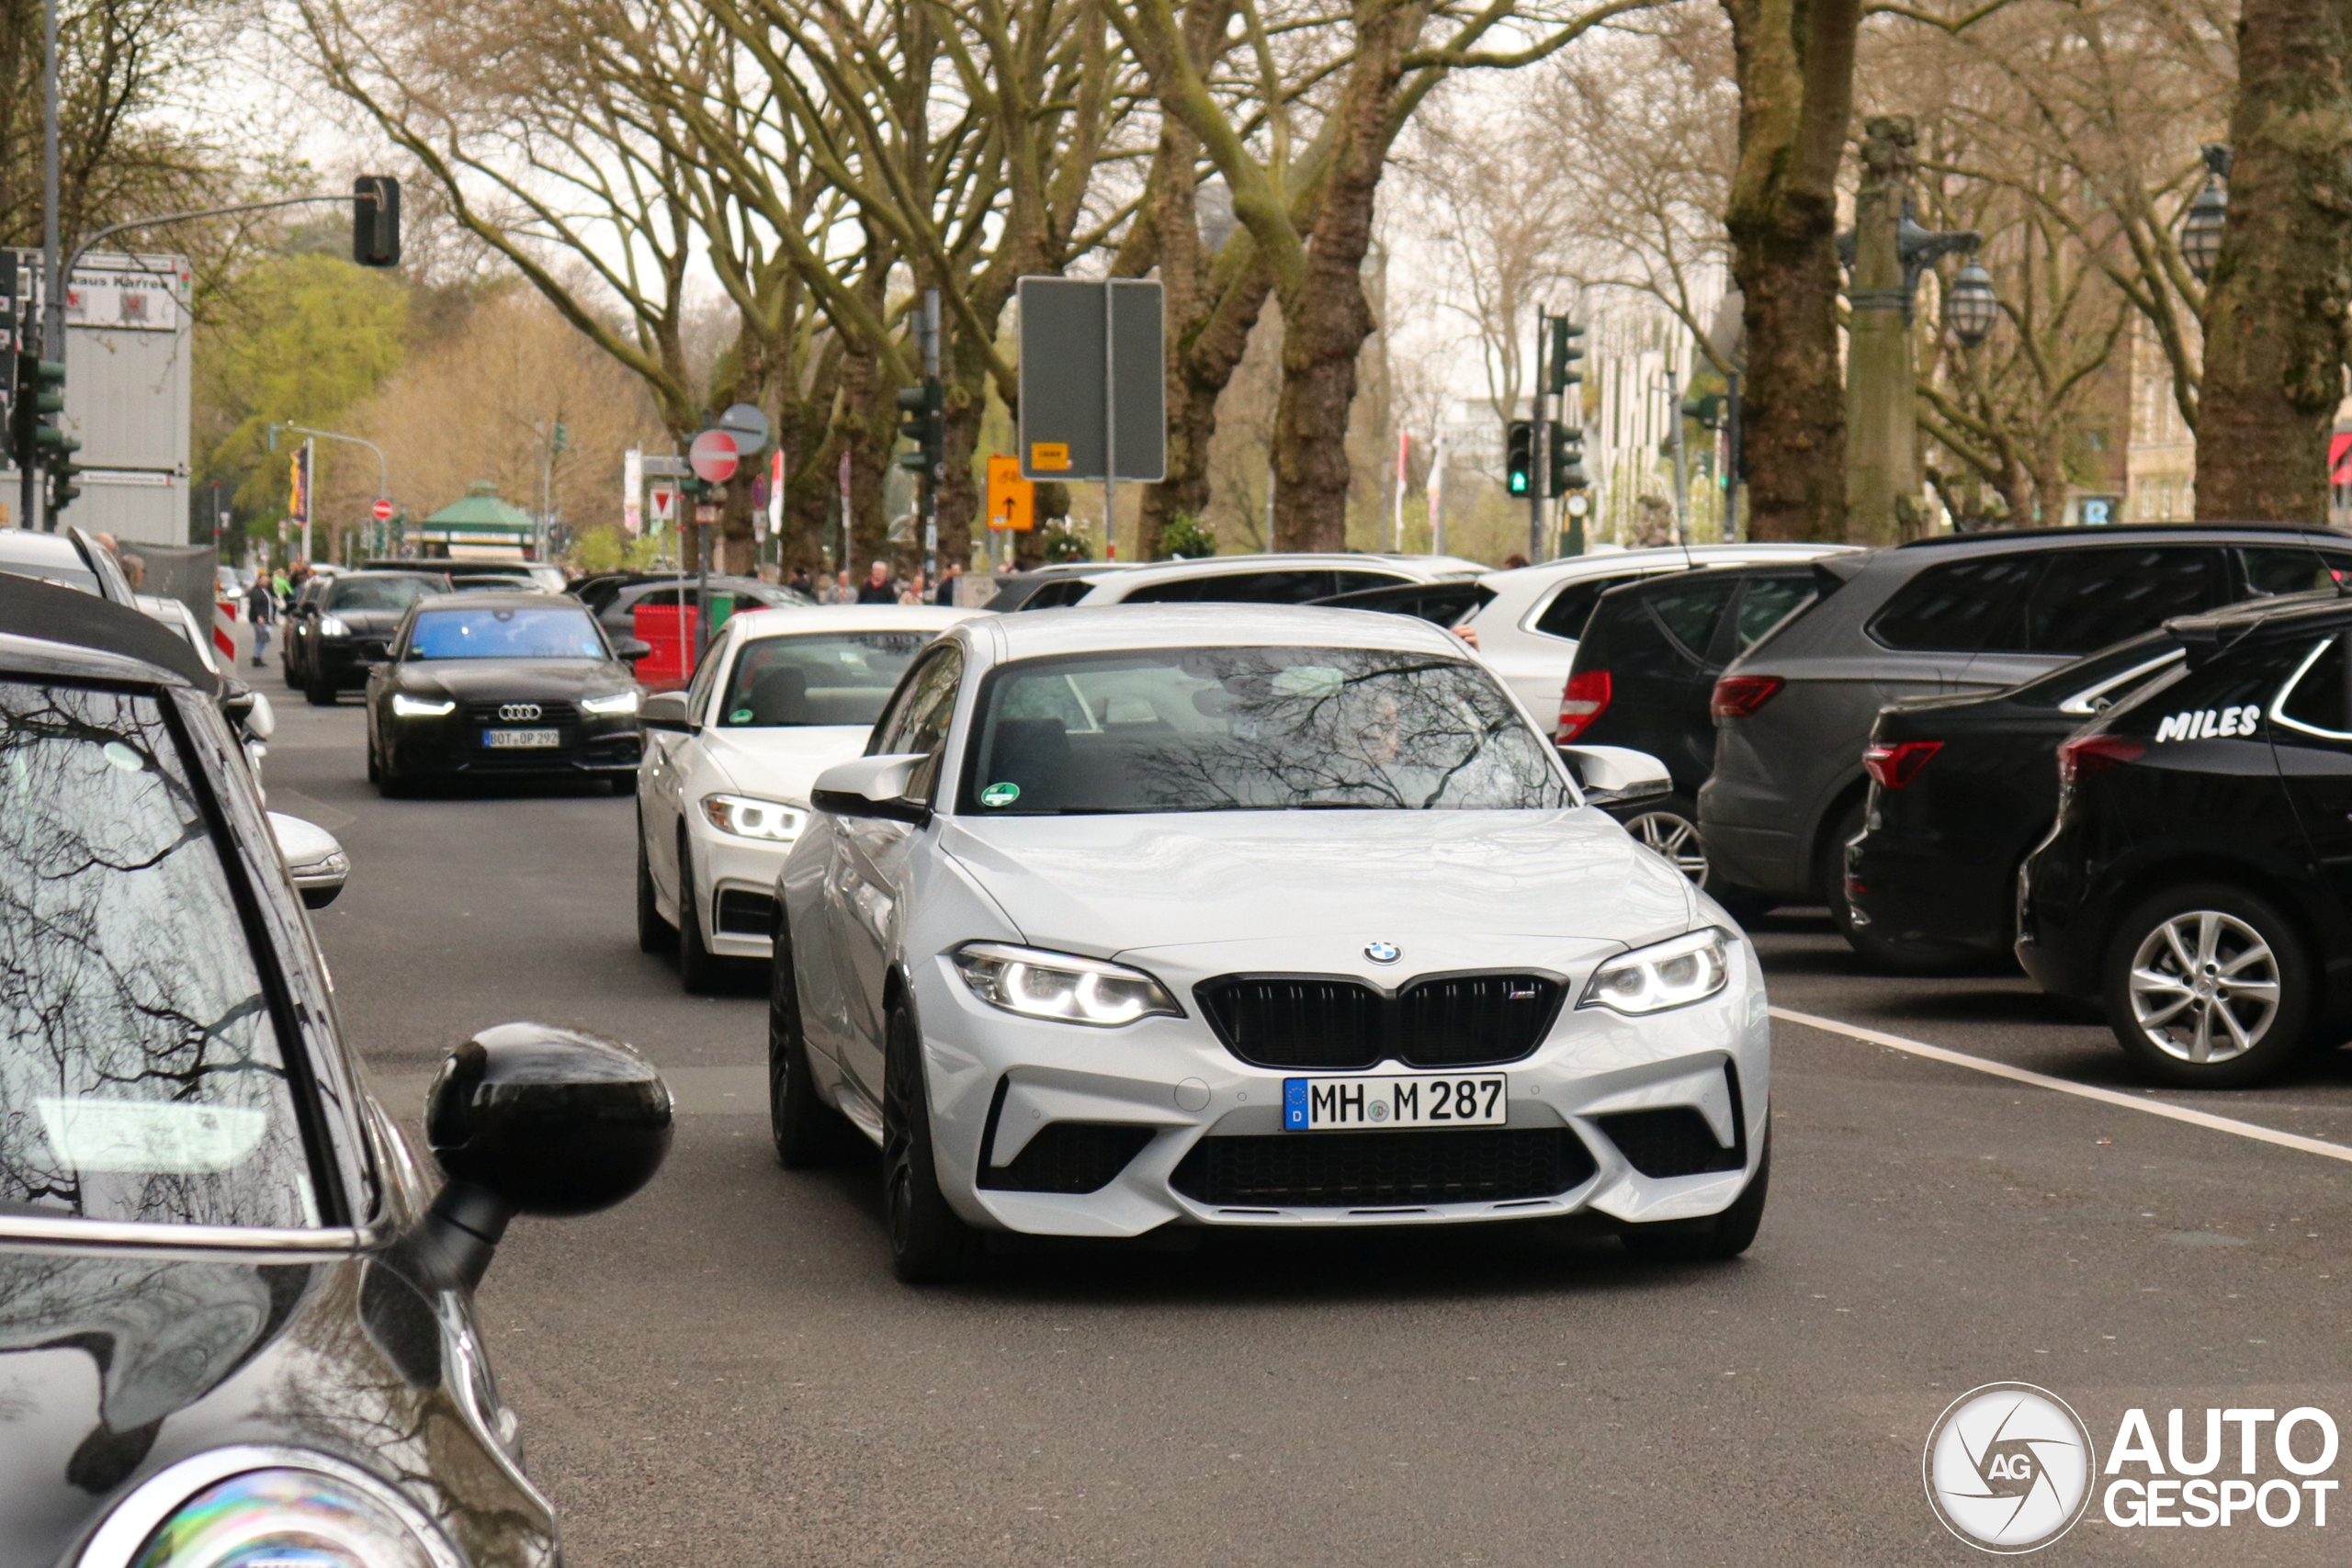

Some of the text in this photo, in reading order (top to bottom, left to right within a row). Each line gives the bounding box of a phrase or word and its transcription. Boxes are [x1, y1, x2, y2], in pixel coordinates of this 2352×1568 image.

[2155, 705, 2261, 743] MILES
[1293, 1079, 1502, 1122] D MH M 287
